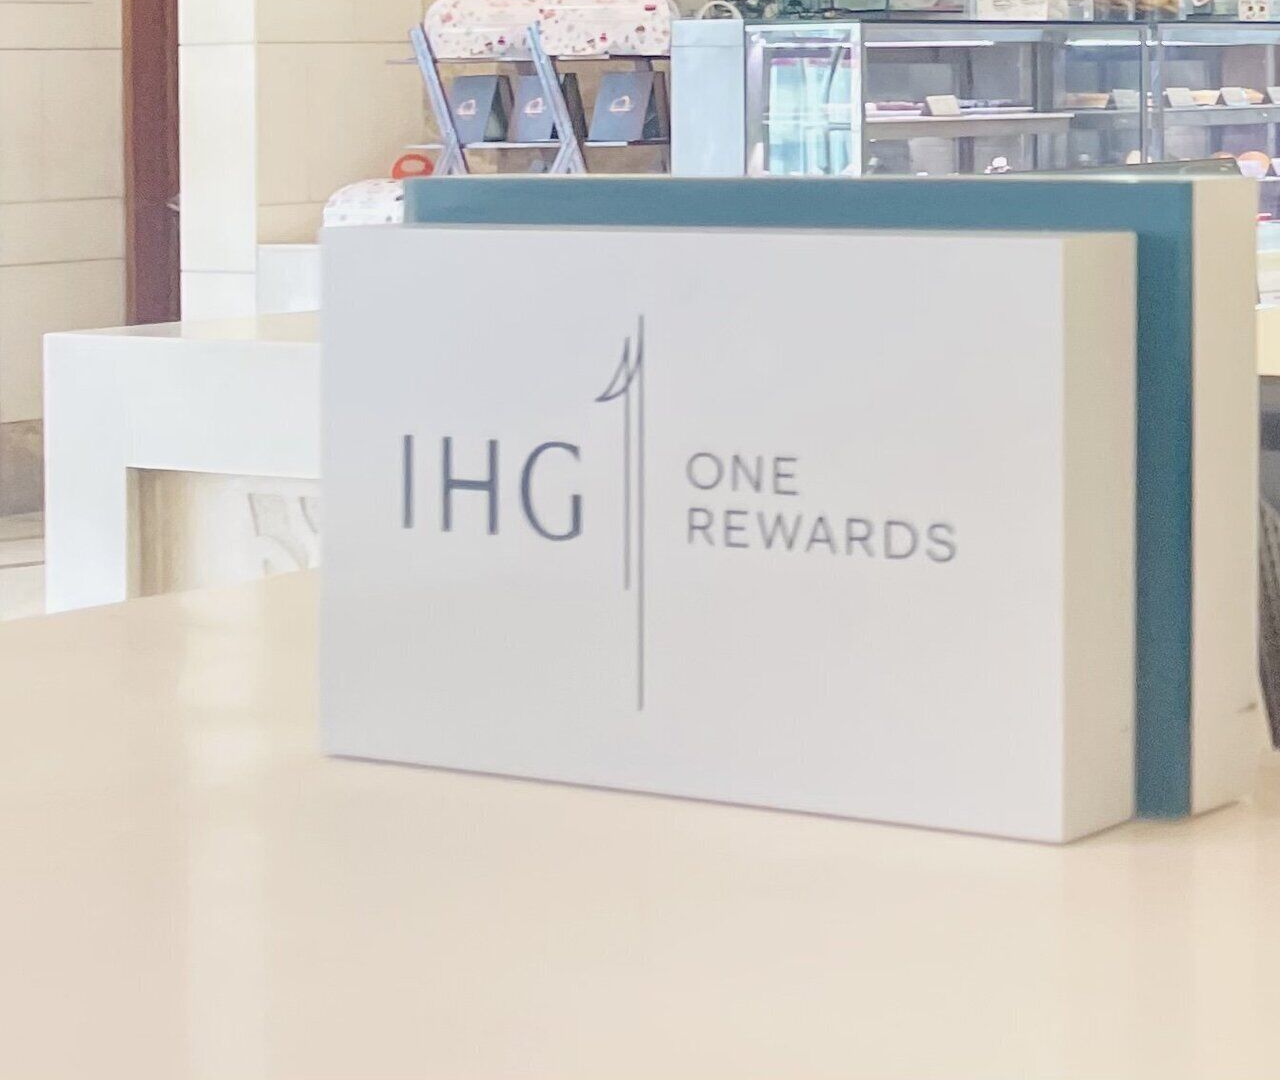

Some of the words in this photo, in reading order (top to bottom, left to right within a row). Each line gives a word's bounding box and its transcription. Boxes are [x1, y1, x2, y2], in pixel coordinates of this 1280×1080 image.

[402, 434, 584, 542] IHG
[685, 451, 800, 497] ONE
[687, 506, 956, 564] REWARDS
